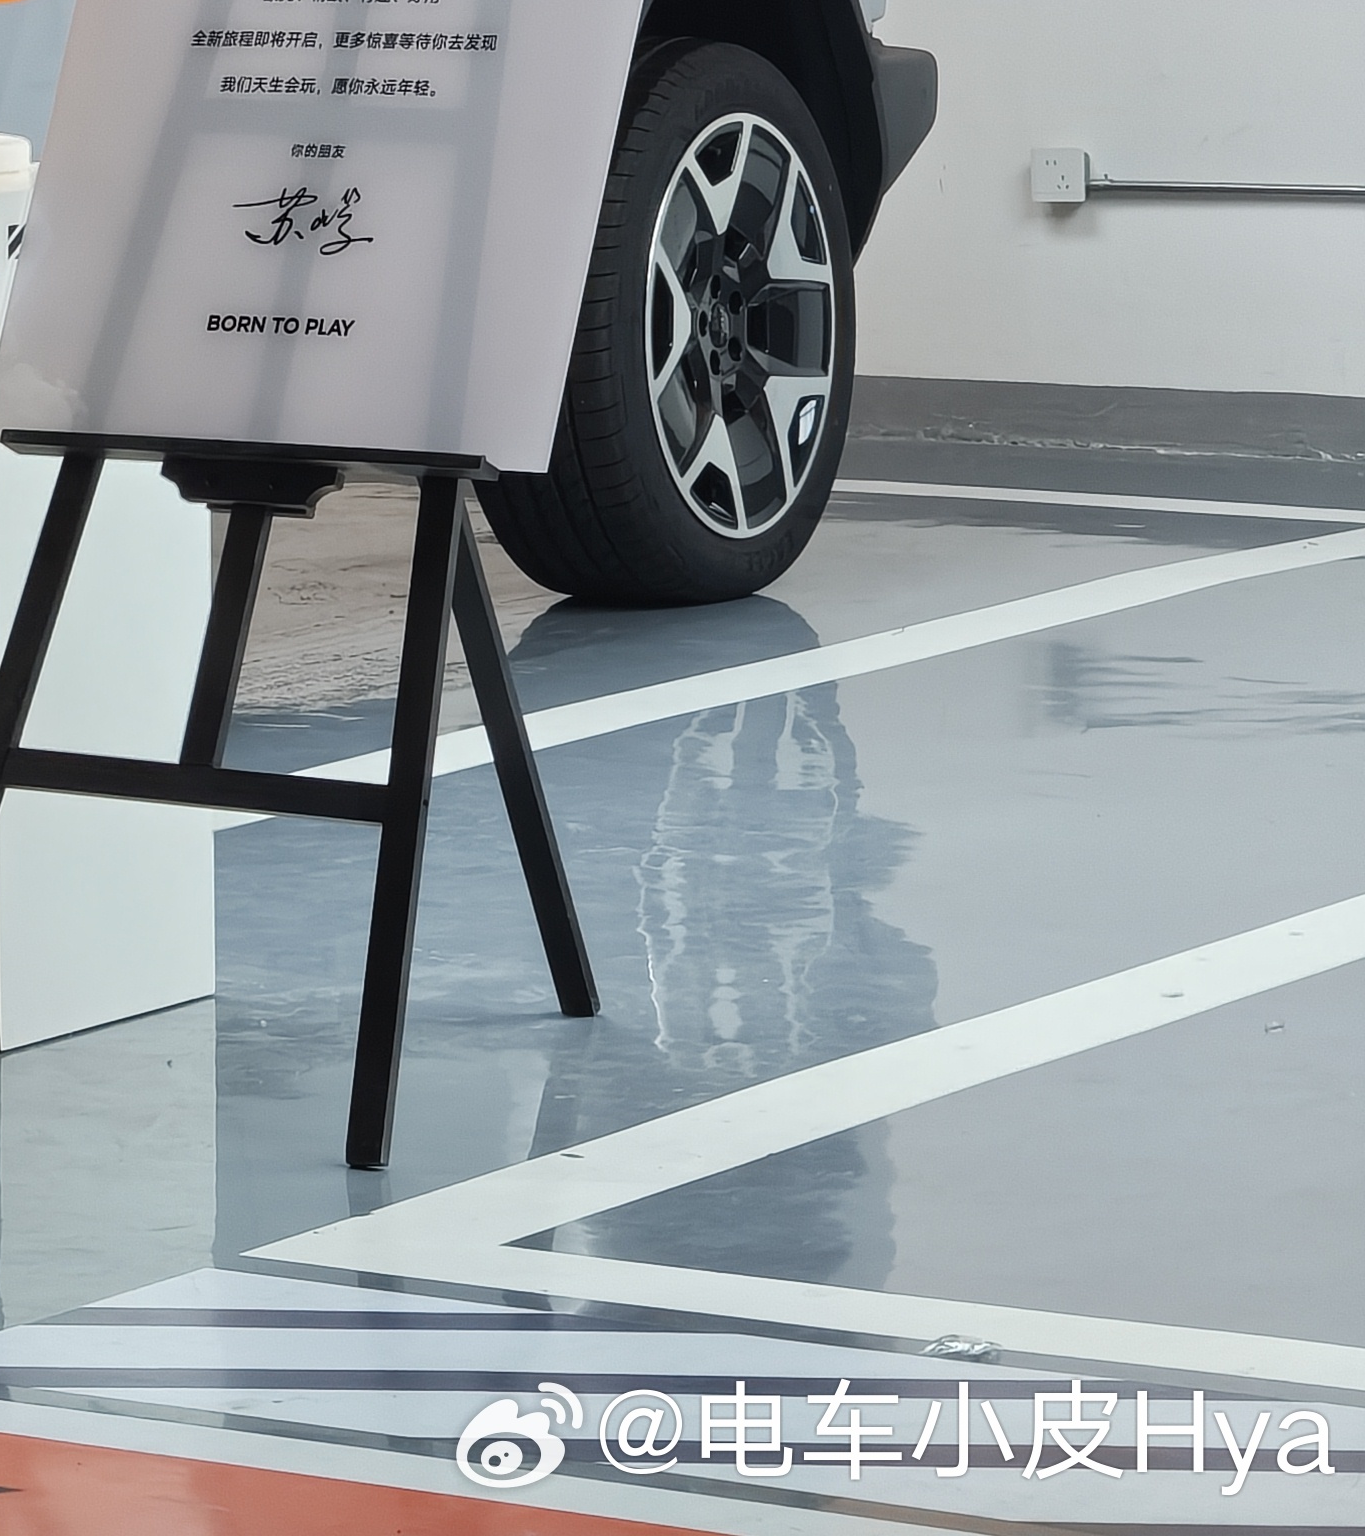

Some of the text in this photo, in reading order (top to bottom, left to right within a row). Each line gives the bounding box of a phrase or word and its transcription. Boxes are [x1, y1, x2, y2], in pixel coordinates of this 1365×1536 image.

[190, 29, 499, 52] 全新旅程即将开启，更多惊喜等待你去发现
[218, 75, 439, 98] 我们天生会玩，愿你永远年轻。
[290, 143, 347, 159] 你的朋友
[206, 314, 356, 337] BORN TO PLAY
